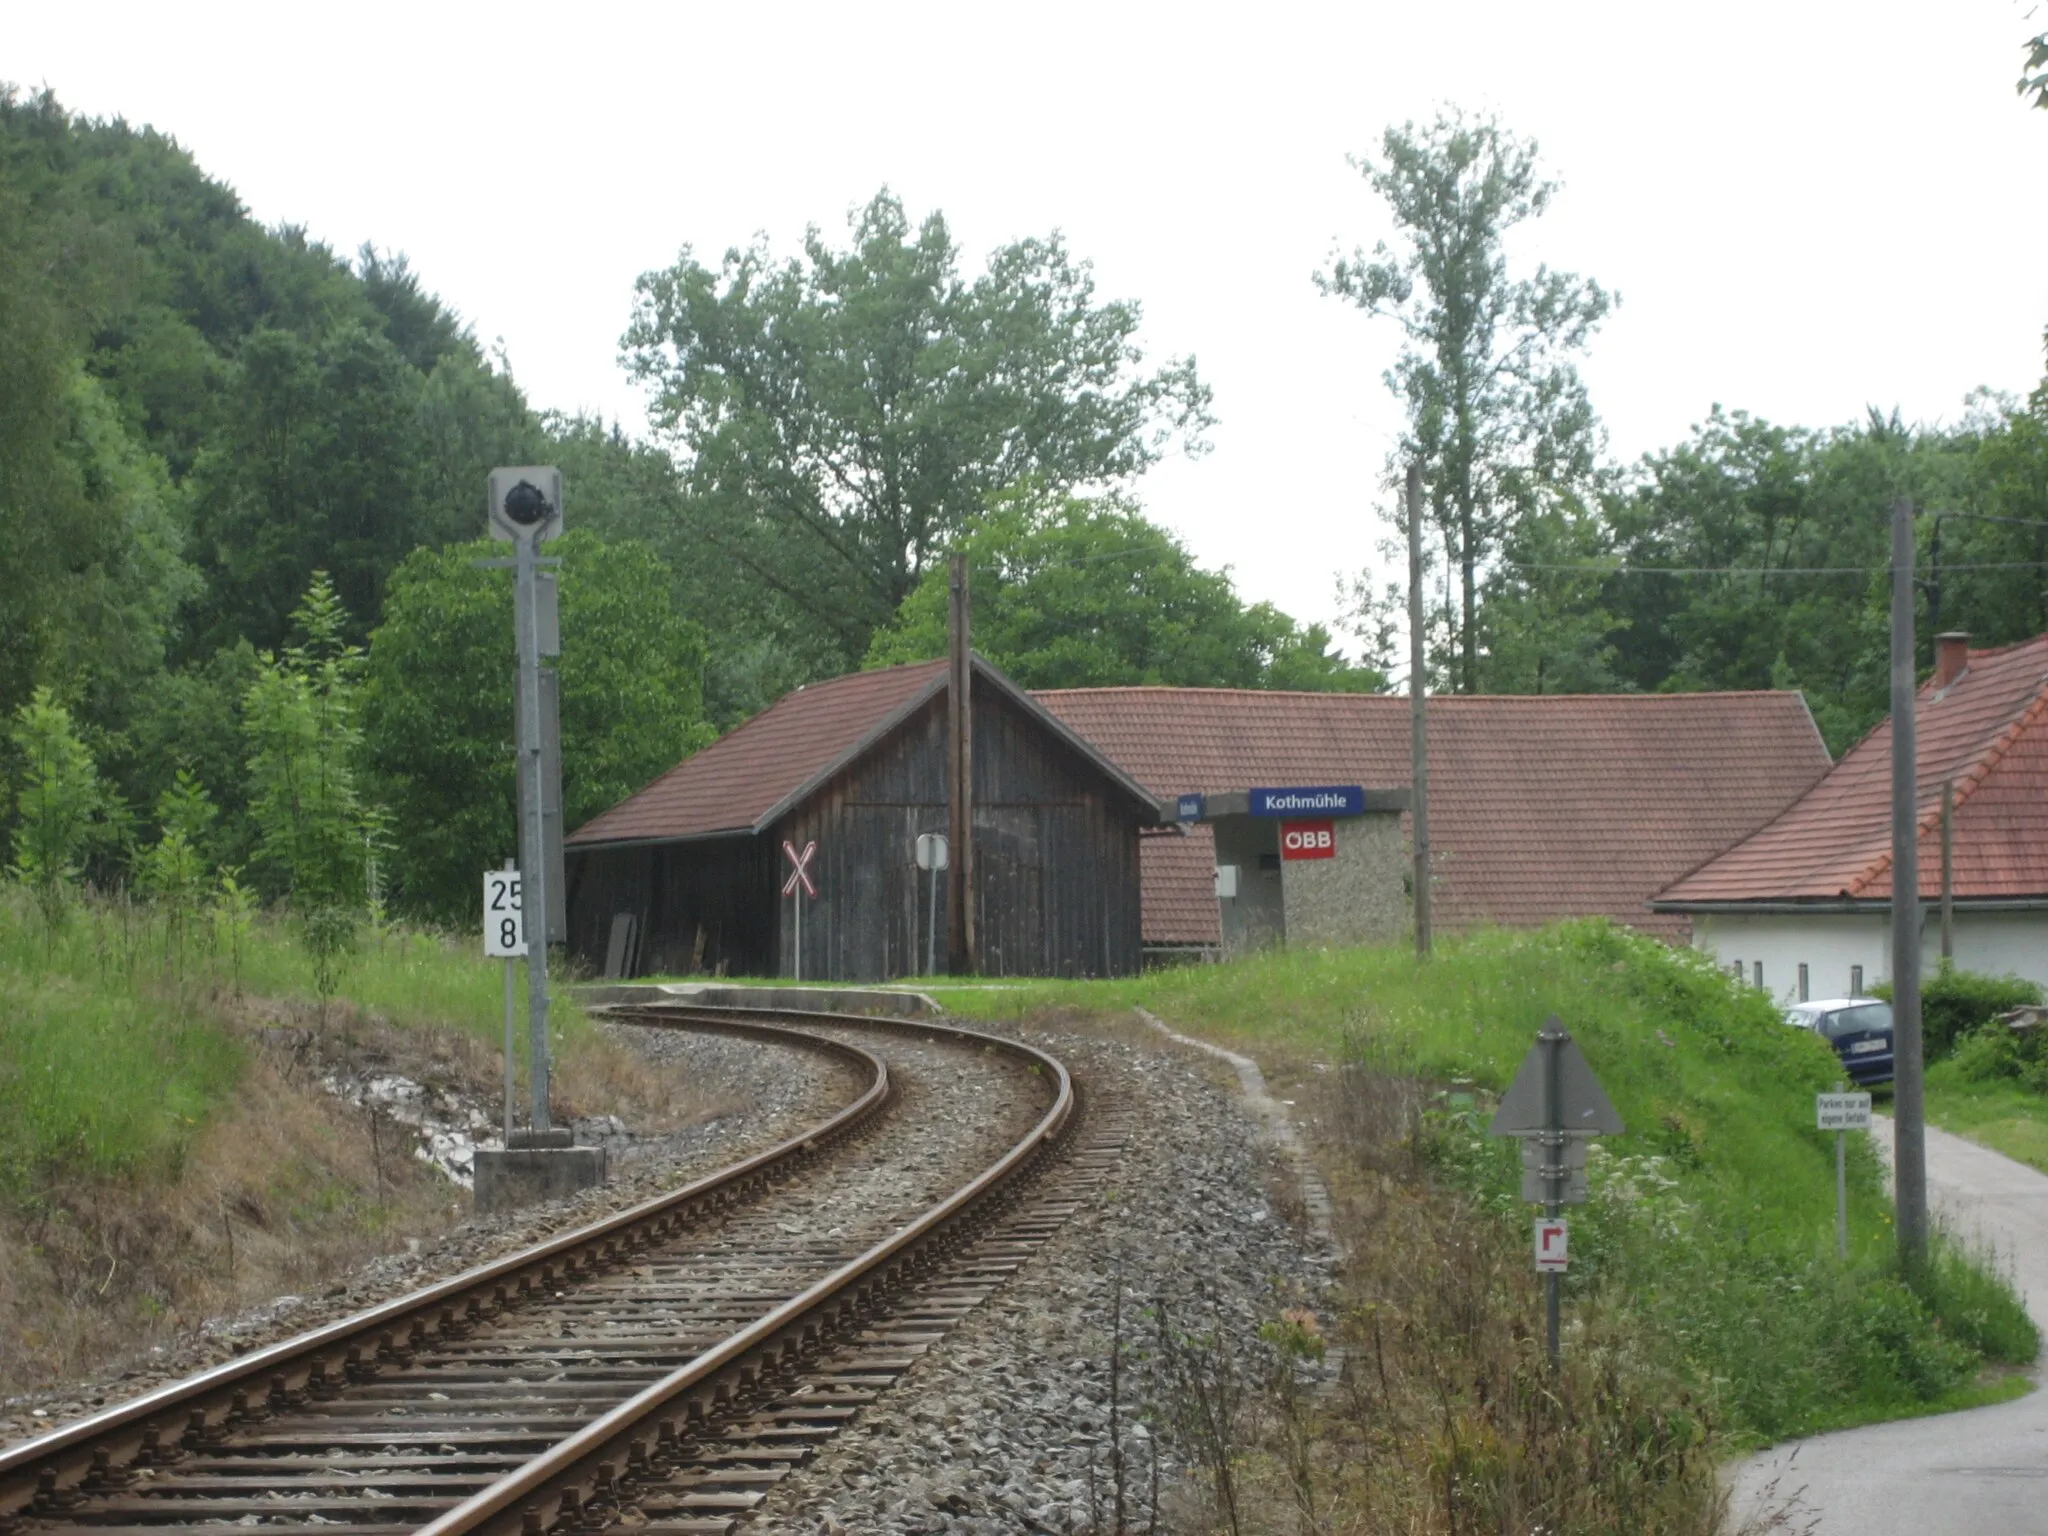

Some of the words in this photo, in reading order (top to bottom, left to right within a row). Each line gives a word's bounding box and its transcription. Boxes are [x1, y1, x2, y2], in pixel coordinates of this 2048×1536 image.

[1266, 793, 1347, 809] Kothmühle
[1285, 831, 1331, 849] ÖBB
[491, 880, 521, 911] 25
[500, 918, 516, 949] 8
